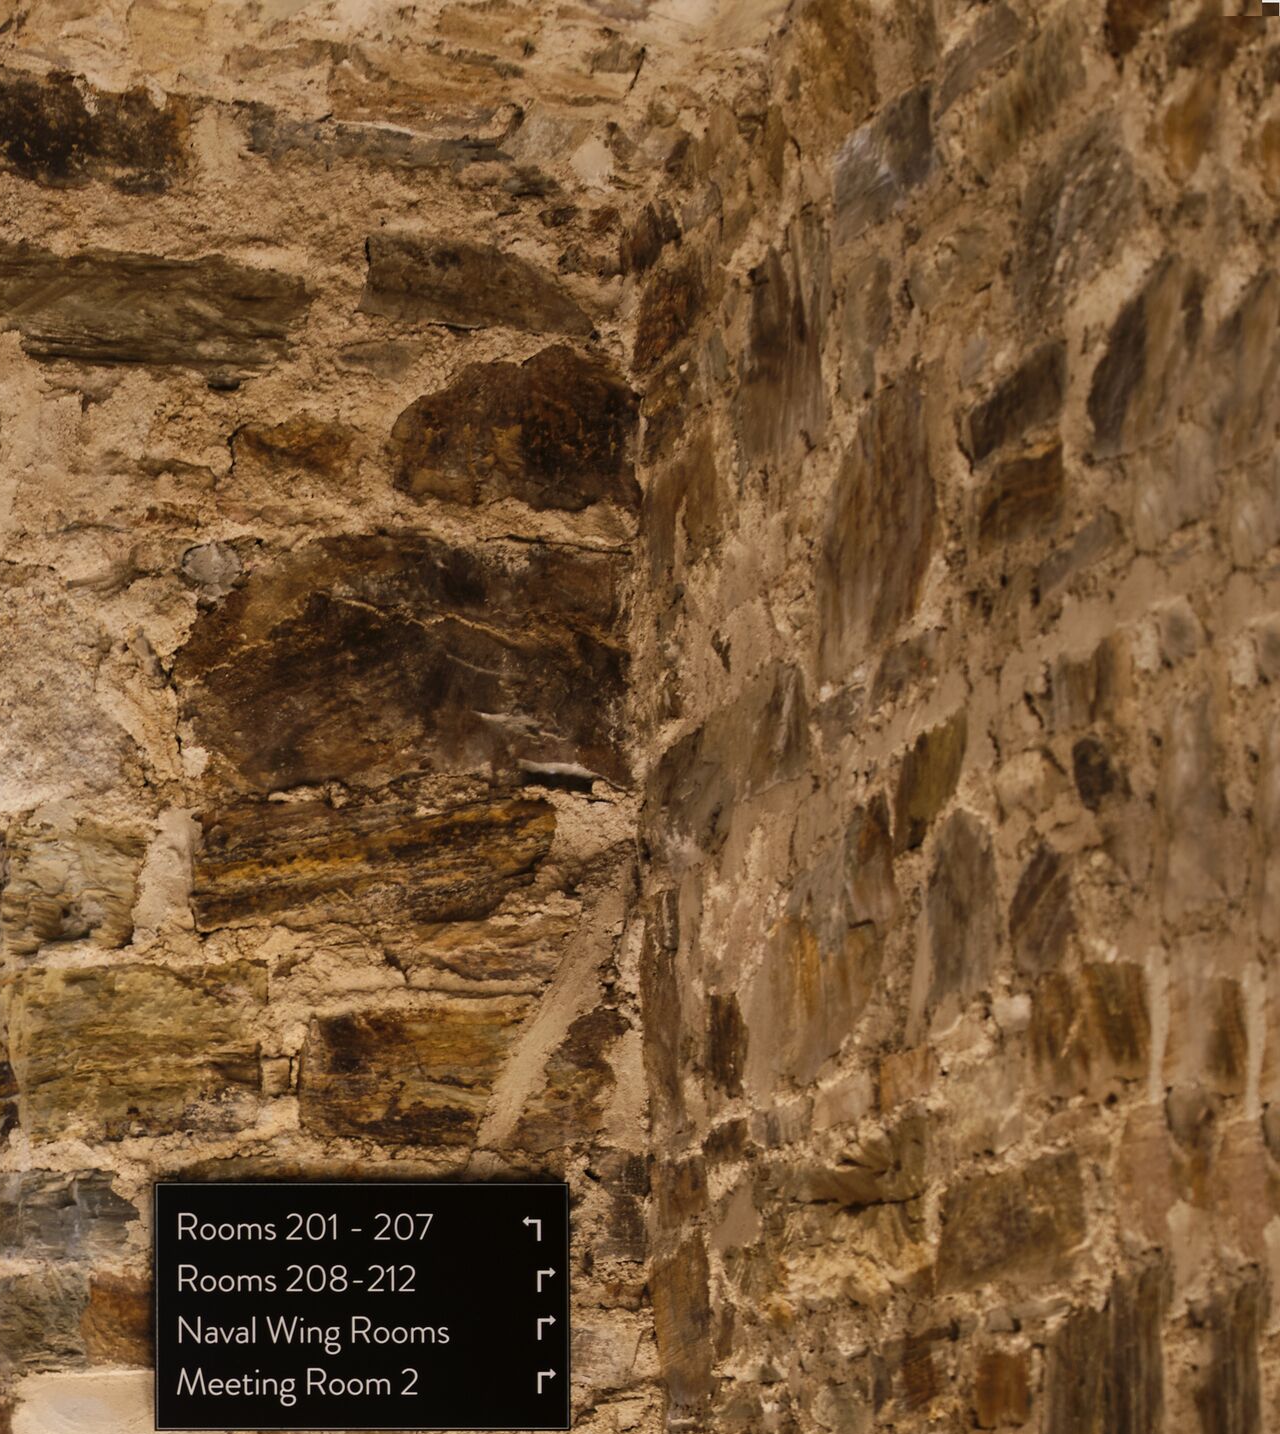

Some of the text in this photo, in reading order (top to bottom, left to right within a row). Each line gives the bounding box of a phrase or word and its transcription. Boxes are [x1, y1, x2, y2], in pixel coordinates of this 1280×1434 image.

[177, 1212, 277, 1241] Rooms
[285, 1212, 337, 1241] 201
[373, 1212, 434, 1241] 207
[177, 1263, 277, 1293] Rooms
[177, 1315, 450, 1356] Naval Wing Rooms
[176, 1367, 420, 1407] Meeting Room 2
